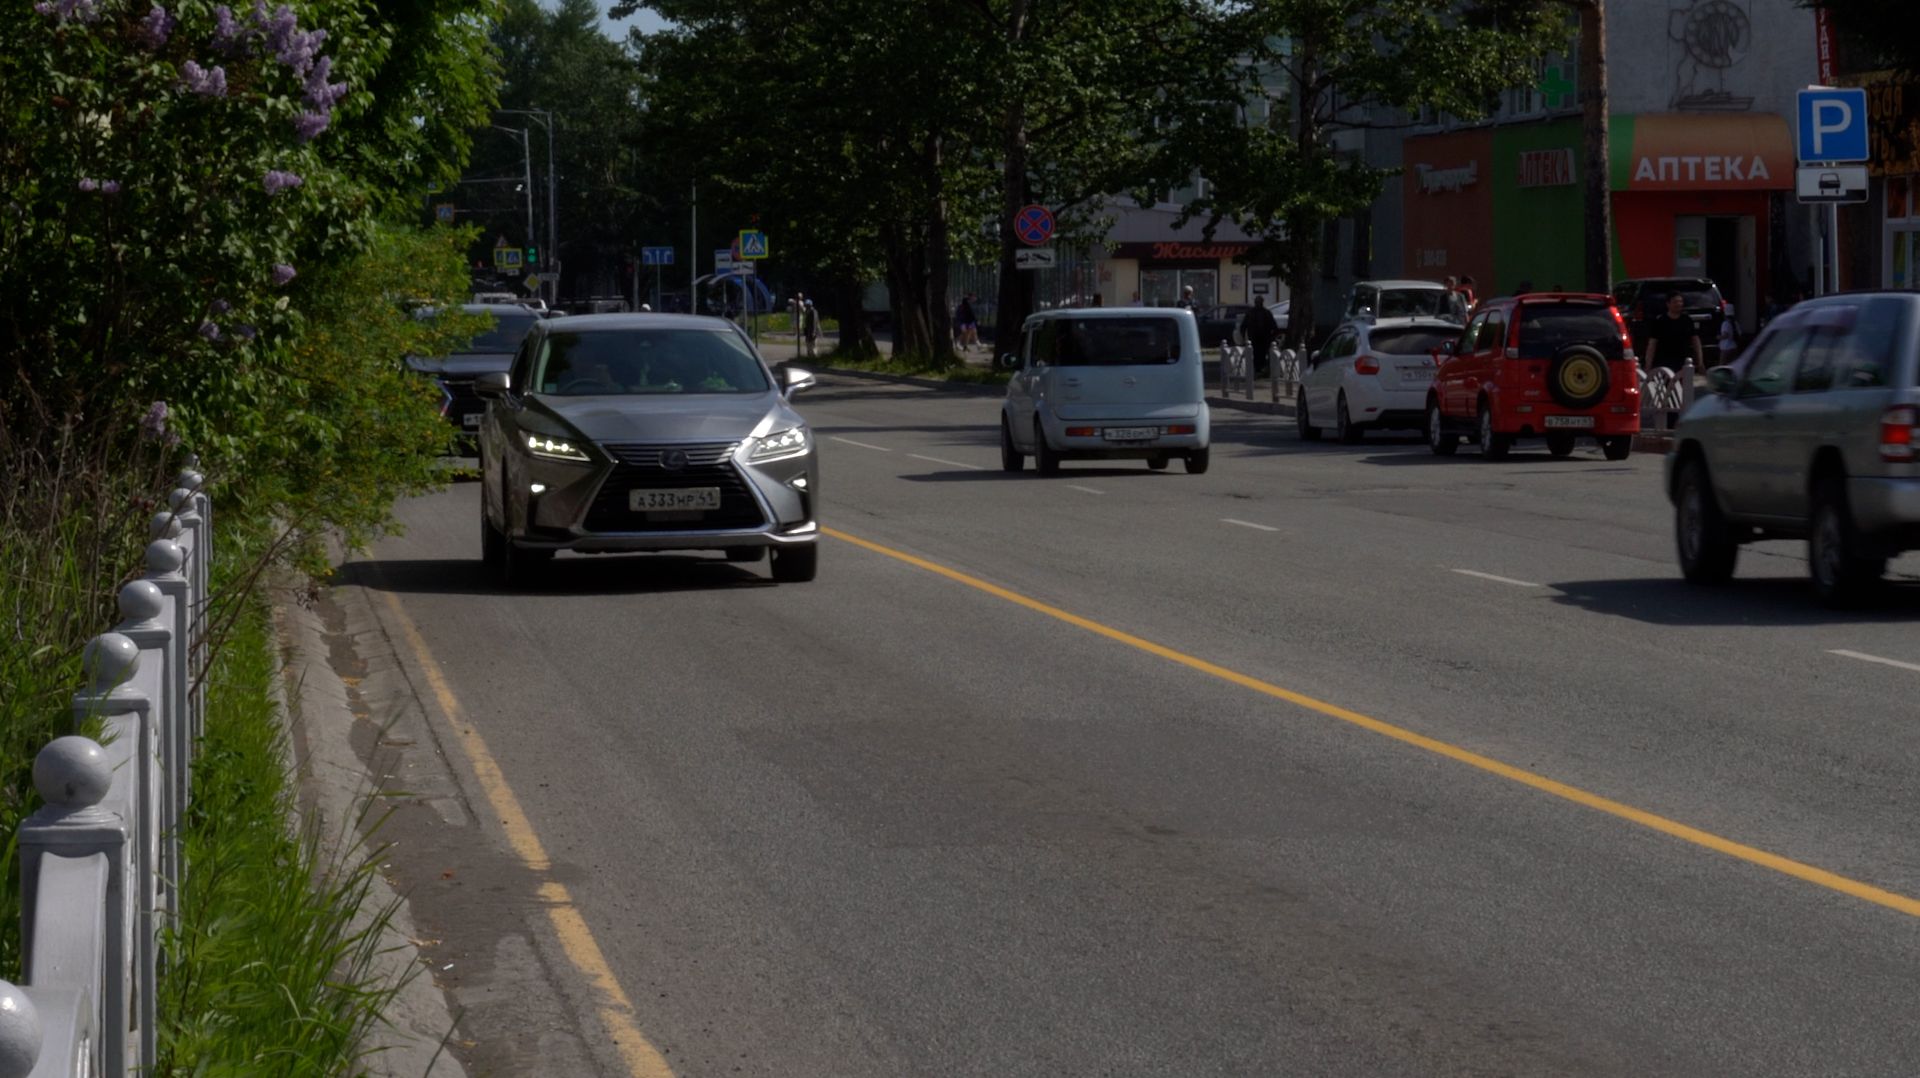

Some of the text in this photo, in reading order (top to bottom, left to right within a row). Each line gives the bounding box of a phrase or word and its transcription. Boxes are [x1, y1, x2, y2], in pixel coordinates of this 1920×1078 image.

[1811, 98, 1853, 155] P
[1517, 150, 1570, 185] АПТЕКА
[1634, 155, 1771, 181] АПТЕКА
